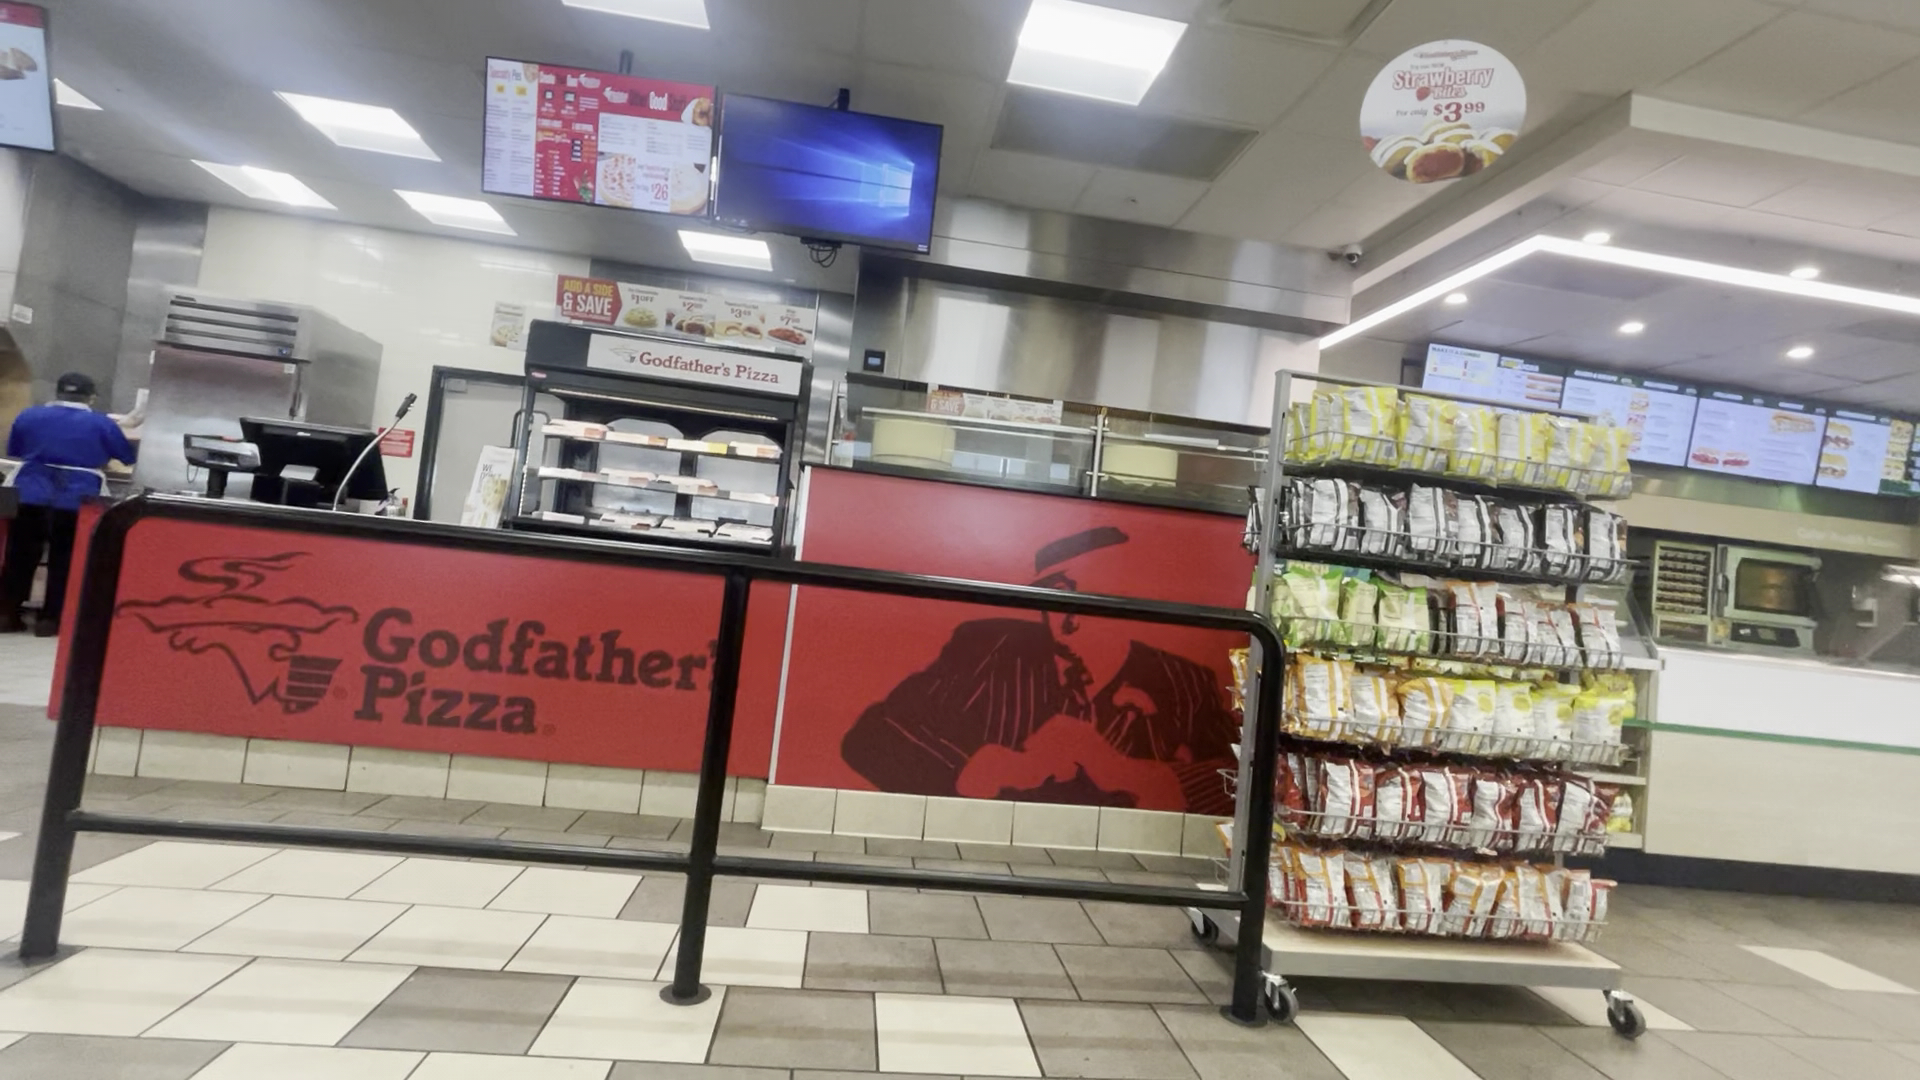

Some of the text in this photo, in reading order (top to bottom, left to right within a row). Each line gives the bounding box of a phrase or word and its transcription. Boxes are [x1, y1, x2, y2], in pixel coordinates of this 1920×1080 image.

[1392, 67, 1494, 90] Strawberry
[563, 279, 583, 293] ADD
[584, 282, 591, 295] A
[593, 283, 614, 297] SIDE
[563, 292, 573, 310] &
[576, 294, 613, 316] SAVE
[639, 351, 779, 384] Godfather's Pizza
[363, 607, 719, 691] Godfather'
[354, 664, 538, 735] Pizza
